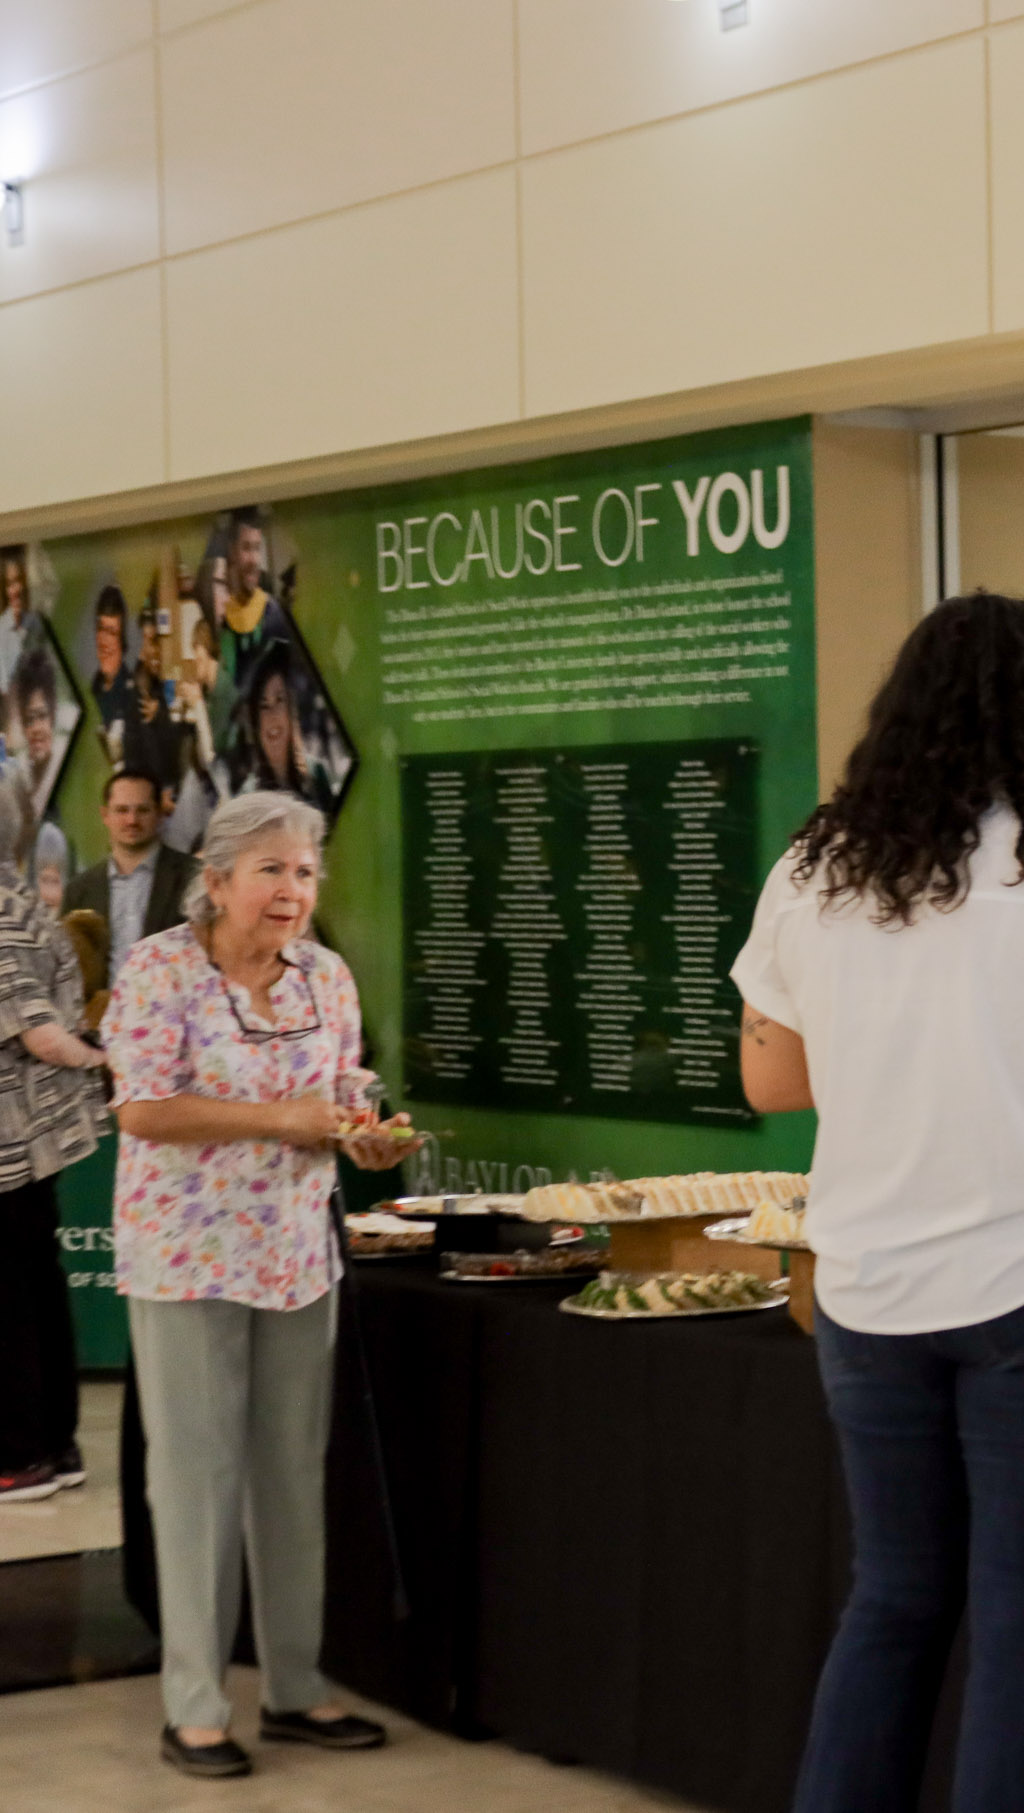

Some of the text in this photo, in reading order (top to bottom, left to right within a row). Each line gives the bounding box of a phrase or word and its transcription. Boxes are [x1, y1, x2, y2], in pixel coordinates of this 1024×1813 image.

[376, 466, 790, 592] BECAUSE OF YOU
